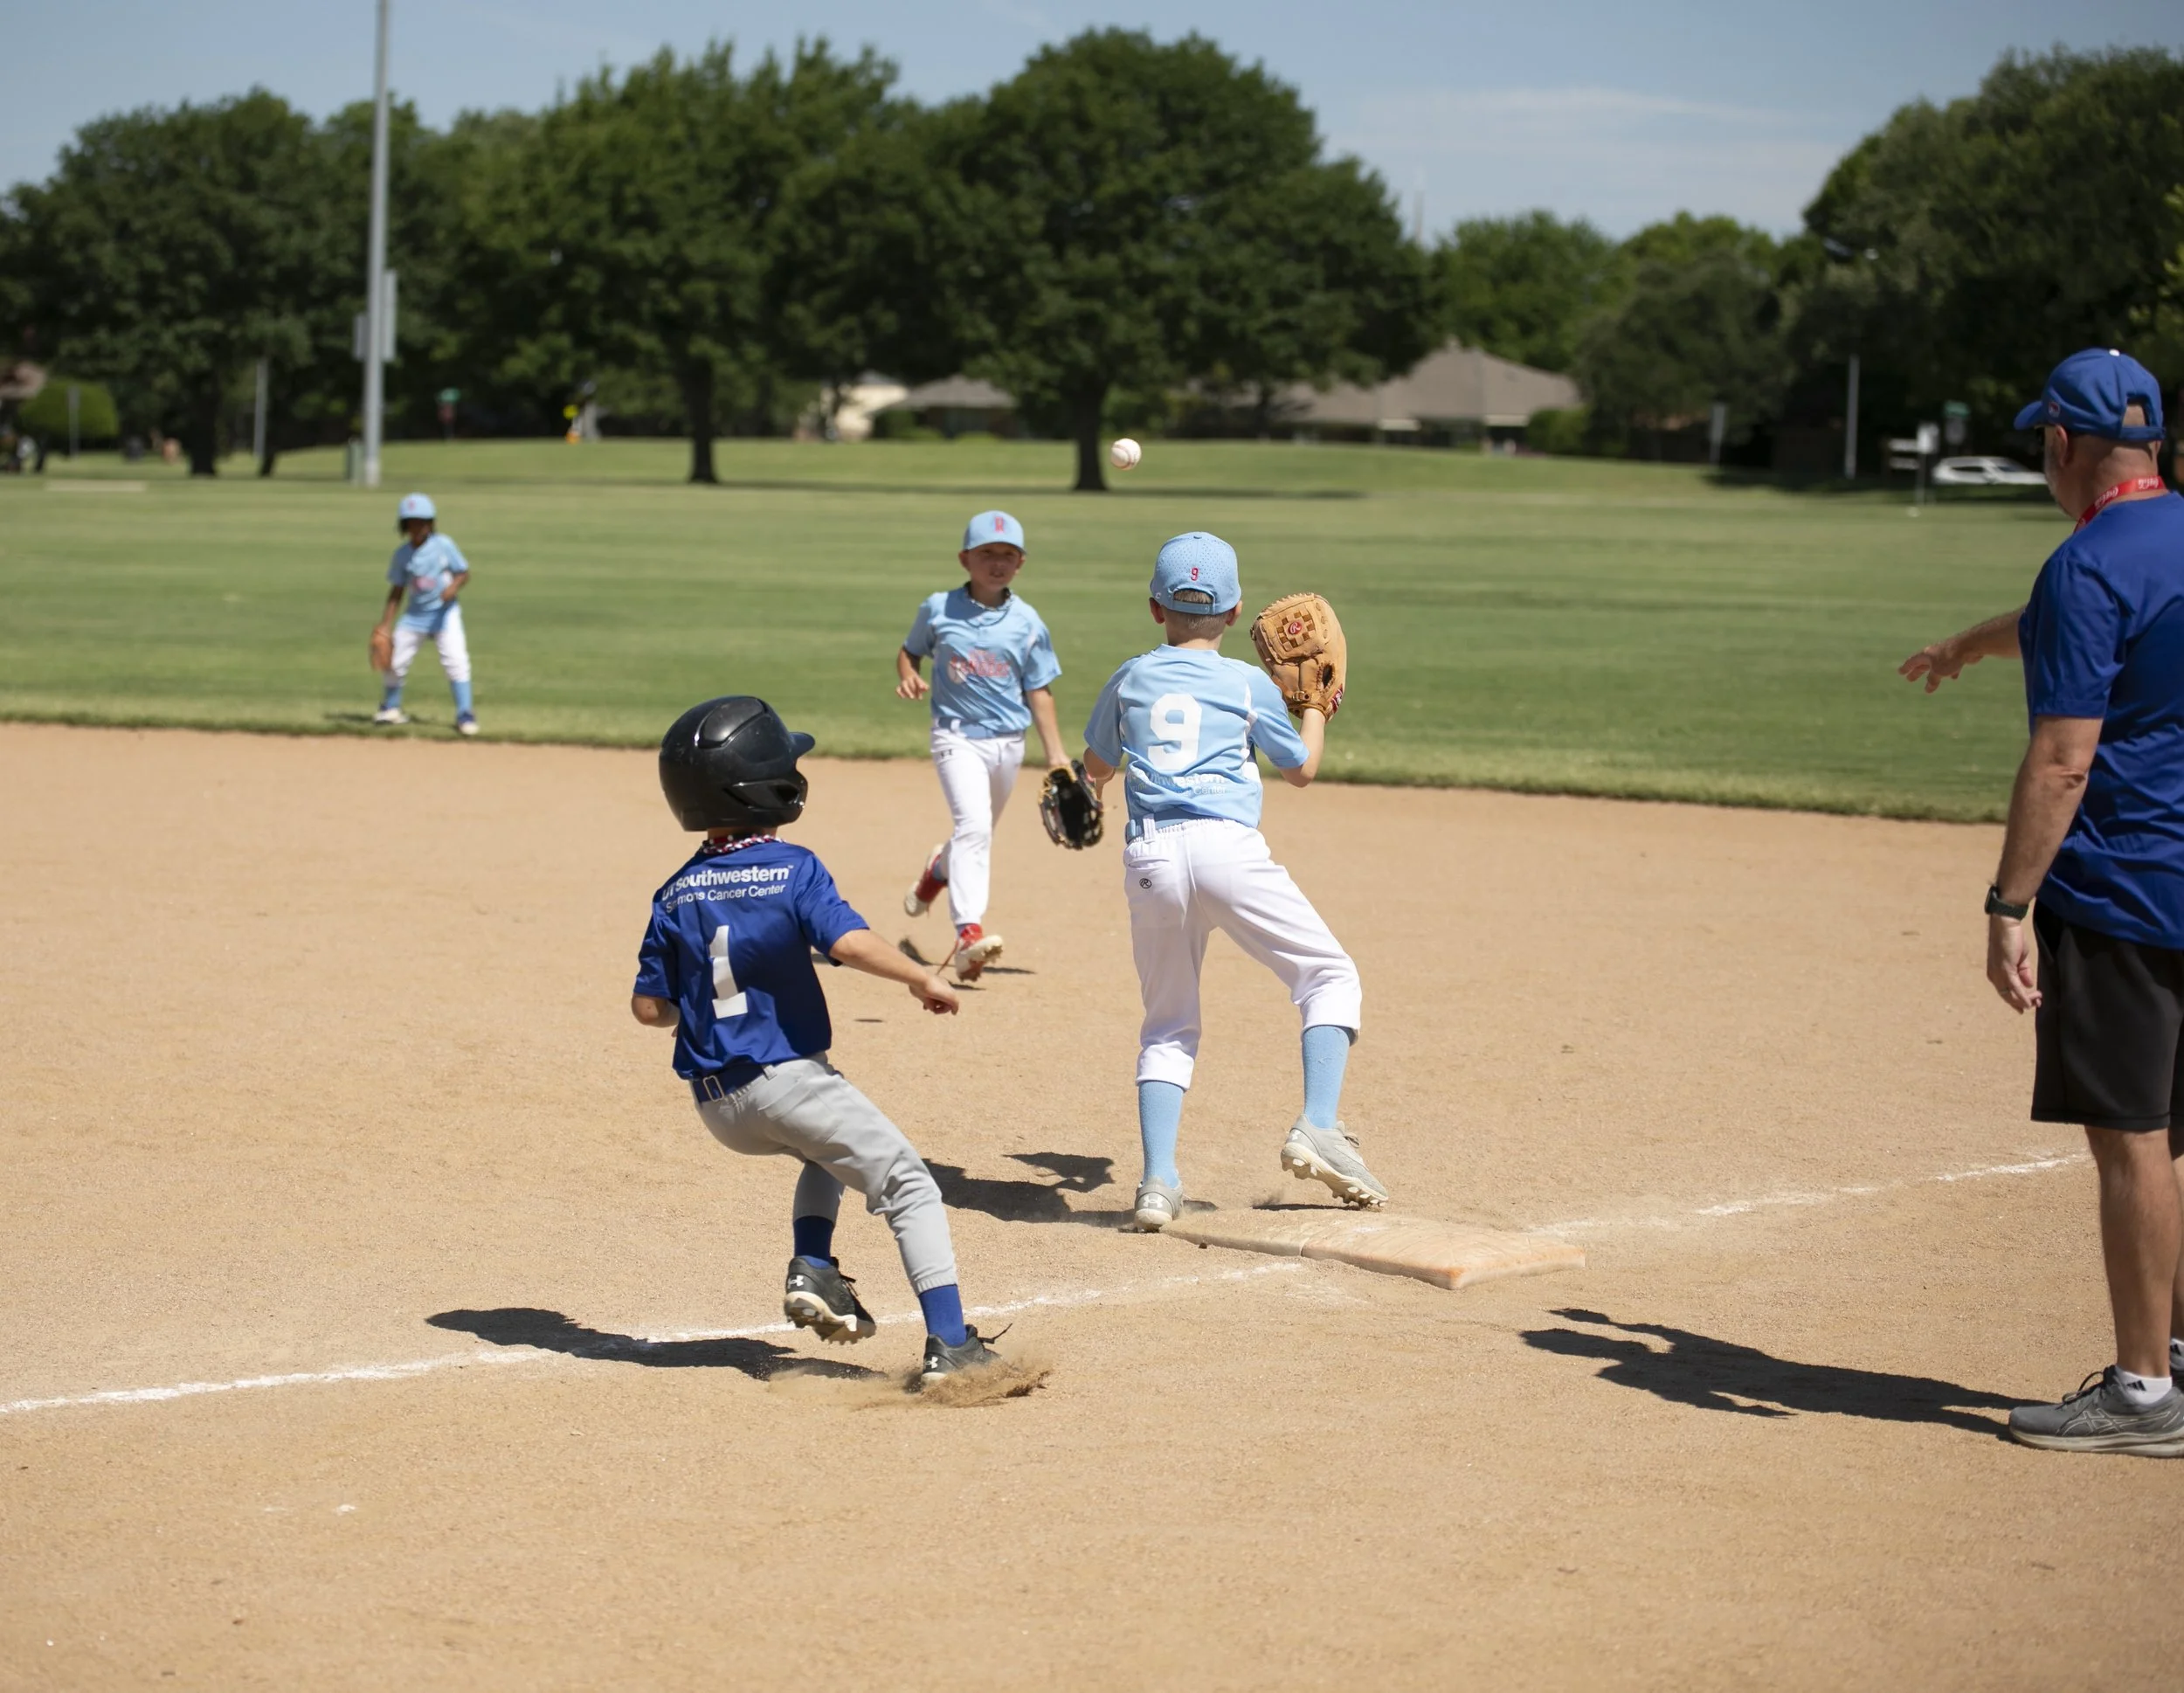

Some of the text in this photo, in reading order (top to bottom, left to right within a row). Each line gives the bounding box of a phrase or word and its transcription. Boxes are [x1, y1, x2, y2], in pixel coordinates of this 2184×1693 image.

[1191, 568, 1199, 581] 9
[1148, 693, 1202, 770] 9
[666, 883, 786, 914] Smos Cancer Center
[709, 925, 748, 1019] 1
